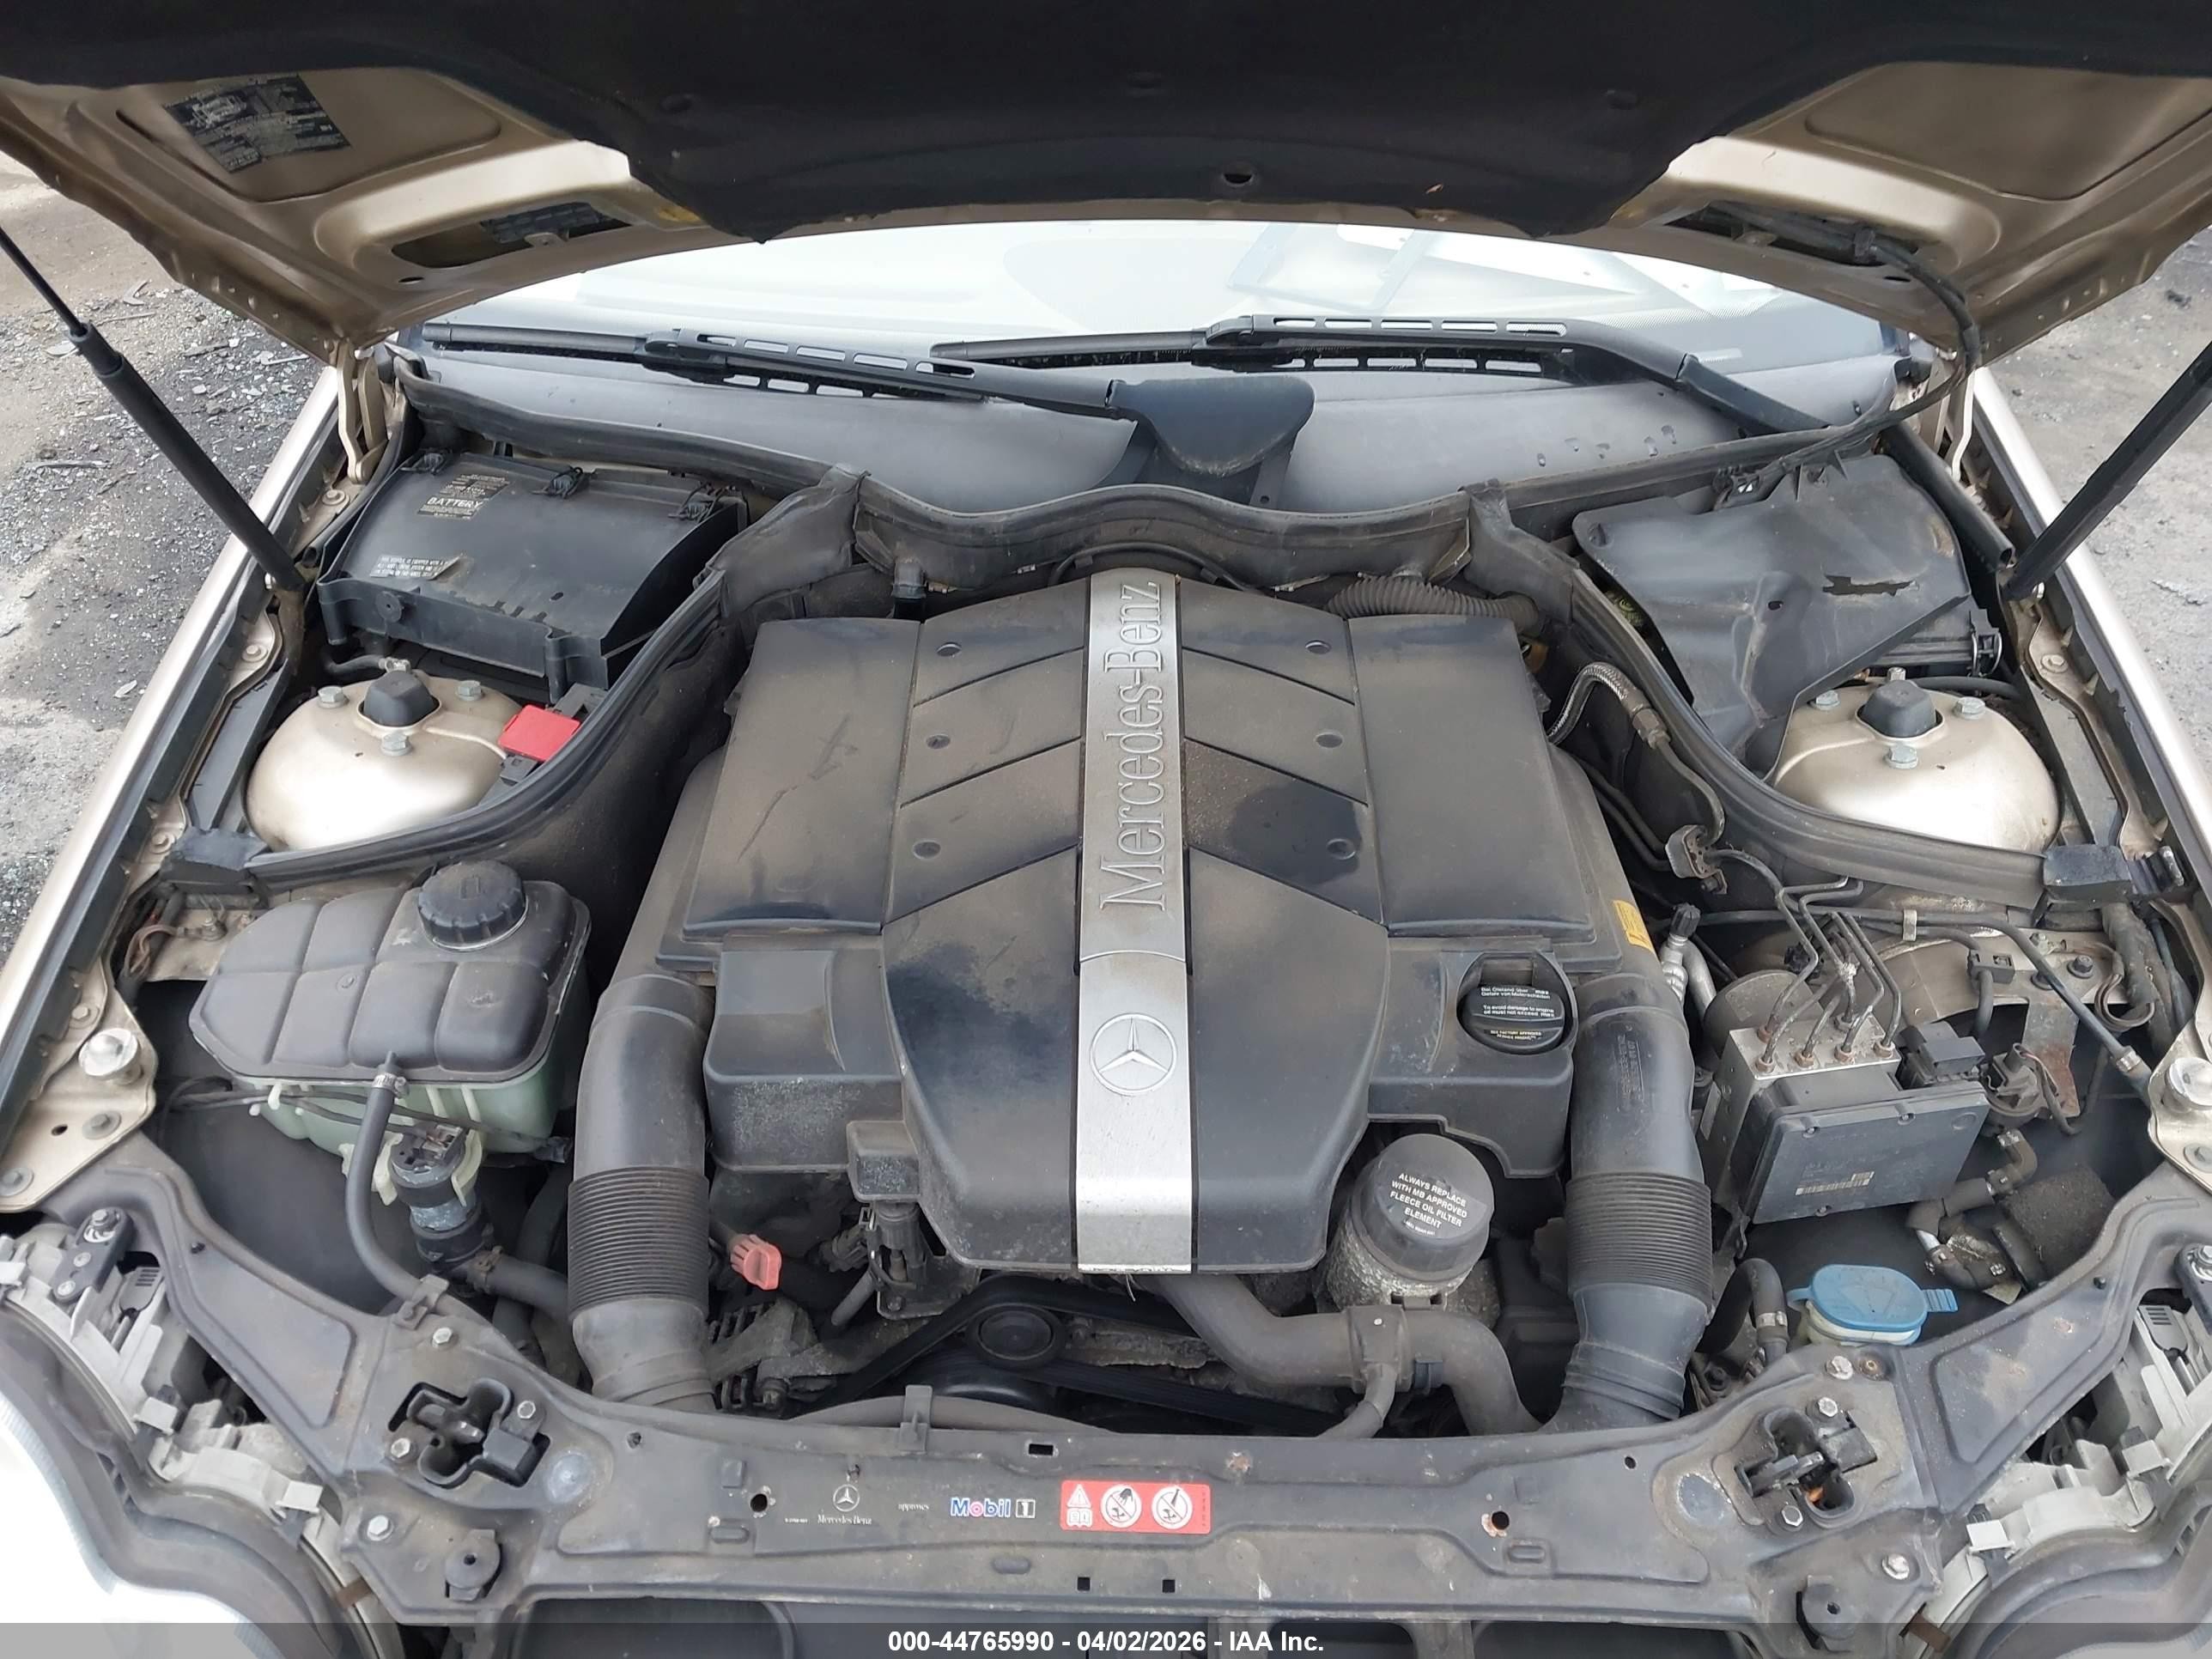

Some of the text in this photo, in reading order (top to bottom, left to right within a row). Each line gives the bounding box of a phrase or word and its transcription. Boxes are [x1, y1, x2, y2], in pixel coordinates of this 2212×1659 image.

[427, 496, 483, 508] BATTERY
[1100, 580, 1165, 912] Mercedes-Benz
[1392, 1180, 1468, 1218] WITH MB APPROVED
[1399, 1173, 1467, 1207] ALWAYS REPLACE
[1390, 1190, 1421, 1208] FLEECE
[1422, 1203, 1435, 1214] OIL
[1436, 1209, 1462, 1227] FILTER
[1404, 1207, 1442, 1229] ELEMENT
[898, 1503, 930, 1511] approves
[951, 1497, 1012, 1518] Mobil
